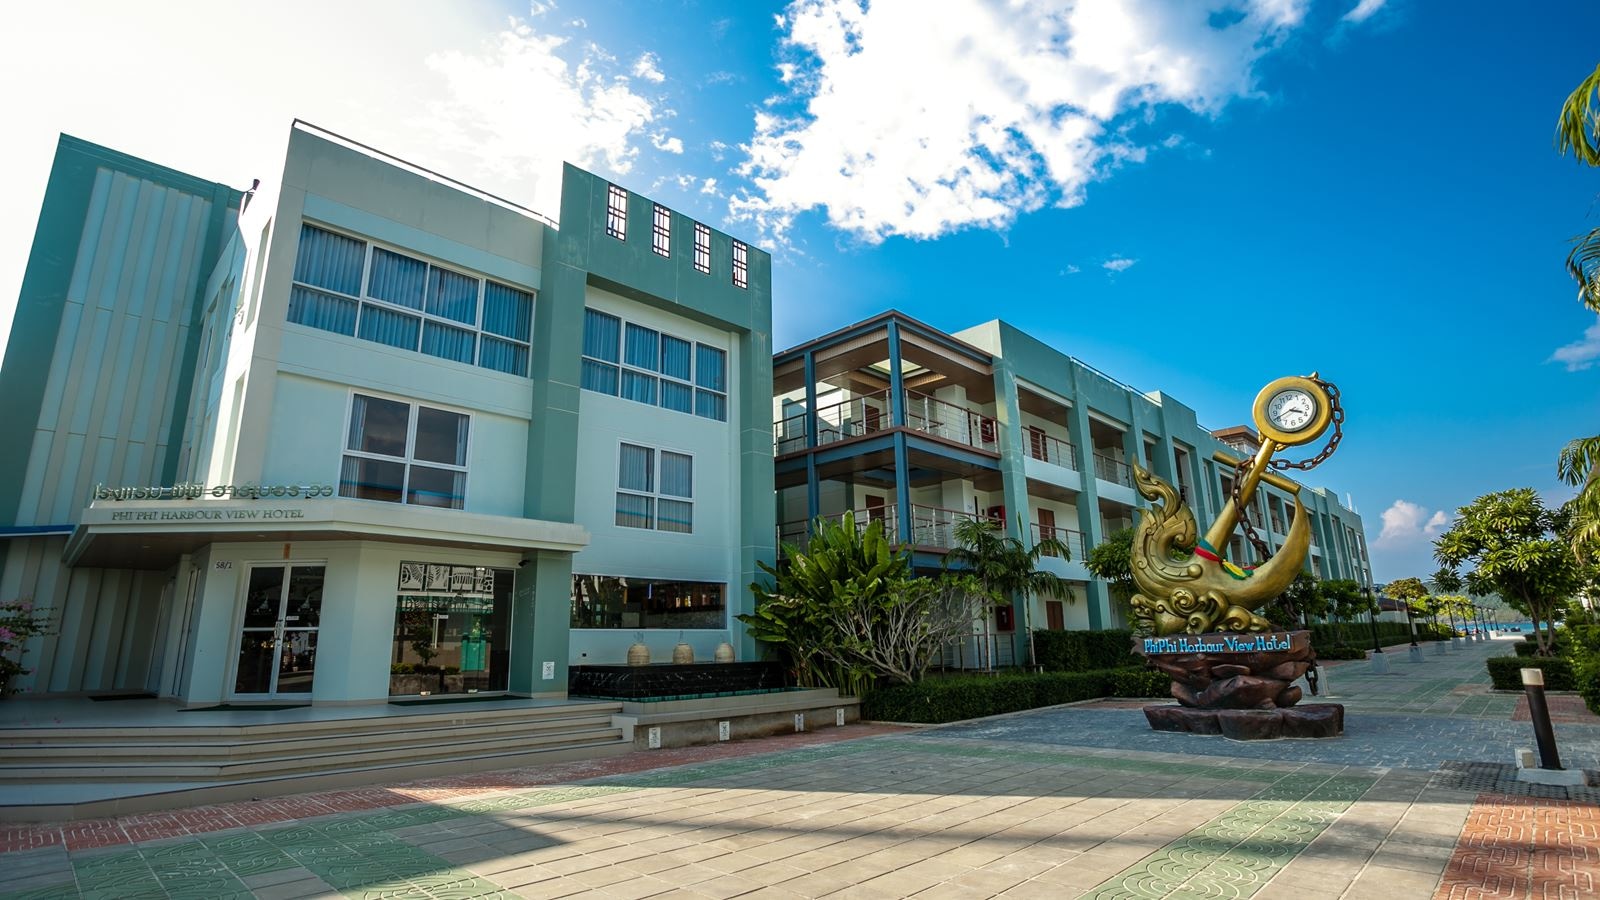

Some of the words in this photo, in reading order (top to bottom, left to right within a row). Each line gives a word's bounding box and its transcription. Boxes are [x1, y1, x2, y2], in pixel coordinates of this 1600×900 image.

[1290, 419, 1297, 427] 6
[1298, 416, 1304, 424] 5
[112, 512, 135, 521] PHI
[136, 511, 158, 521] PHI
[160, 509, 222, 520] HARBOUR
[225, 509, 259, 520] VIEW
[262, 508, 305, 519] HOTEL
[1144, 638, 1177, 653] PhiPhi
[1178, 637, 1225, 653] Harbour
[1223, 635, 1254, 652] View
[1254, 633, 1291, 651] Hotel
